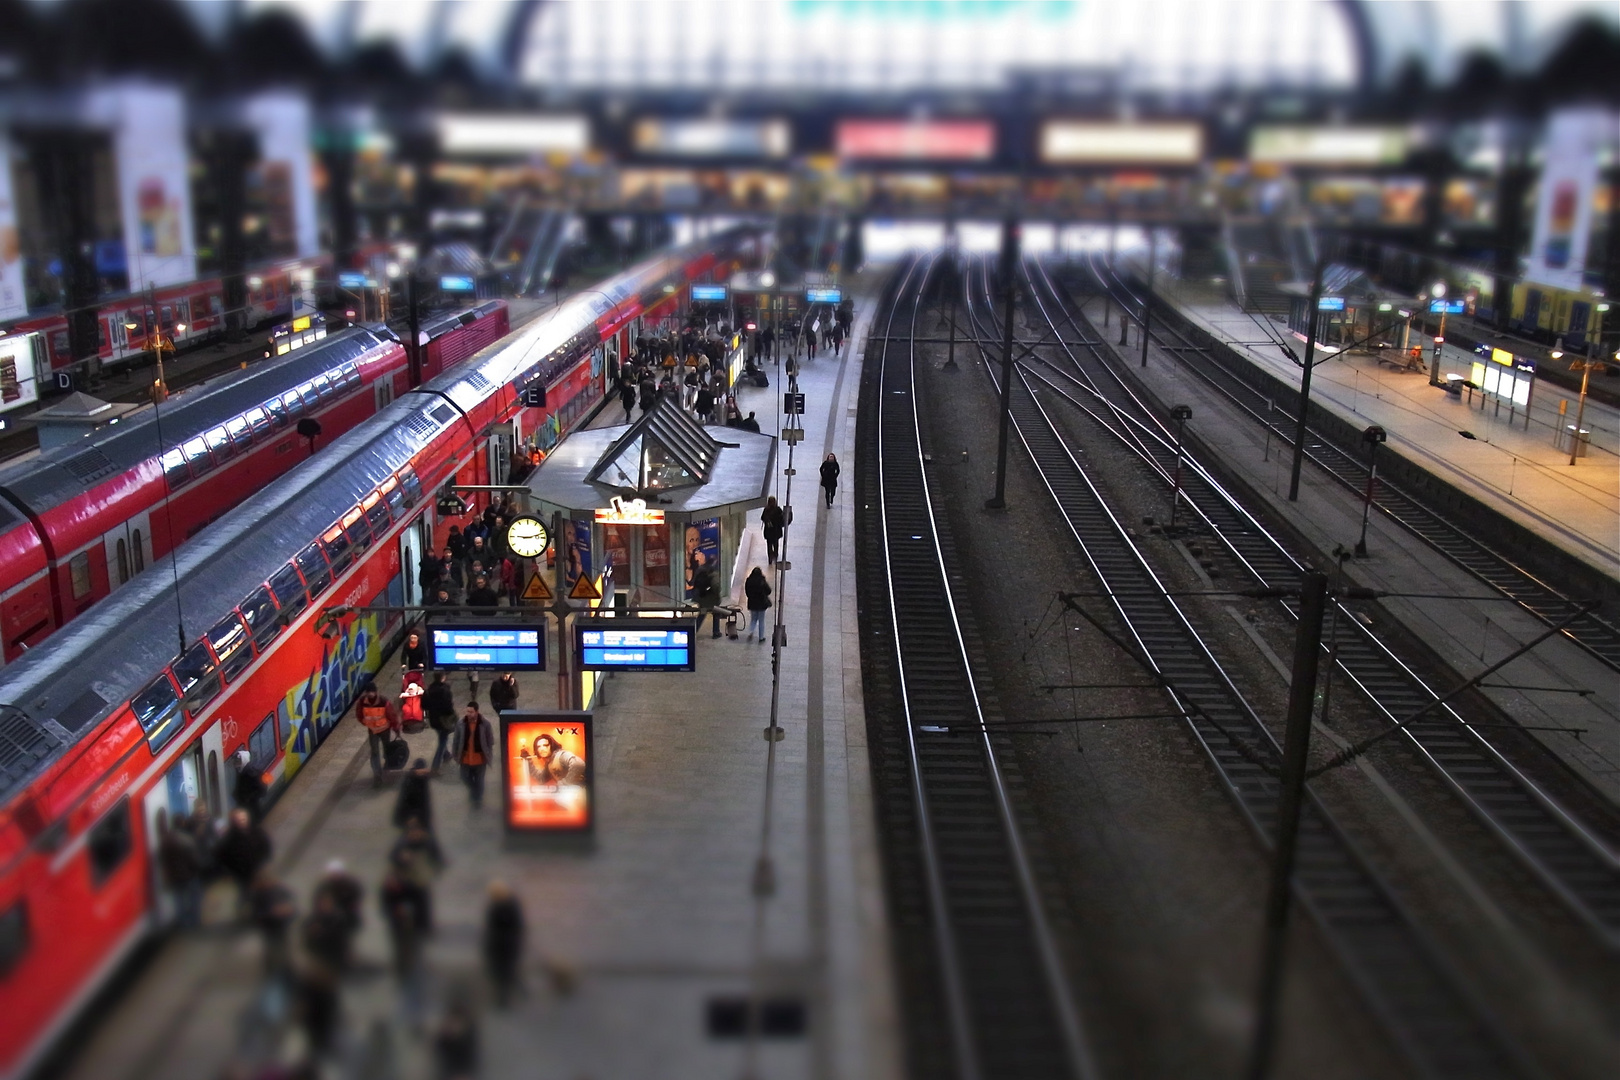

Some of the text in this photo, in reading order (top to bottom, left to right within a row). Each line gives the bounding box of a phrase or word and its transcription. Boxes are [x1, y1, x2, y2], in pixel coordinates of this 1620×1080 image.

[58, 373, 70, 388] D
[528, 388, 538, 403] E
[91, 771, 130, 813] Scharbeutz
